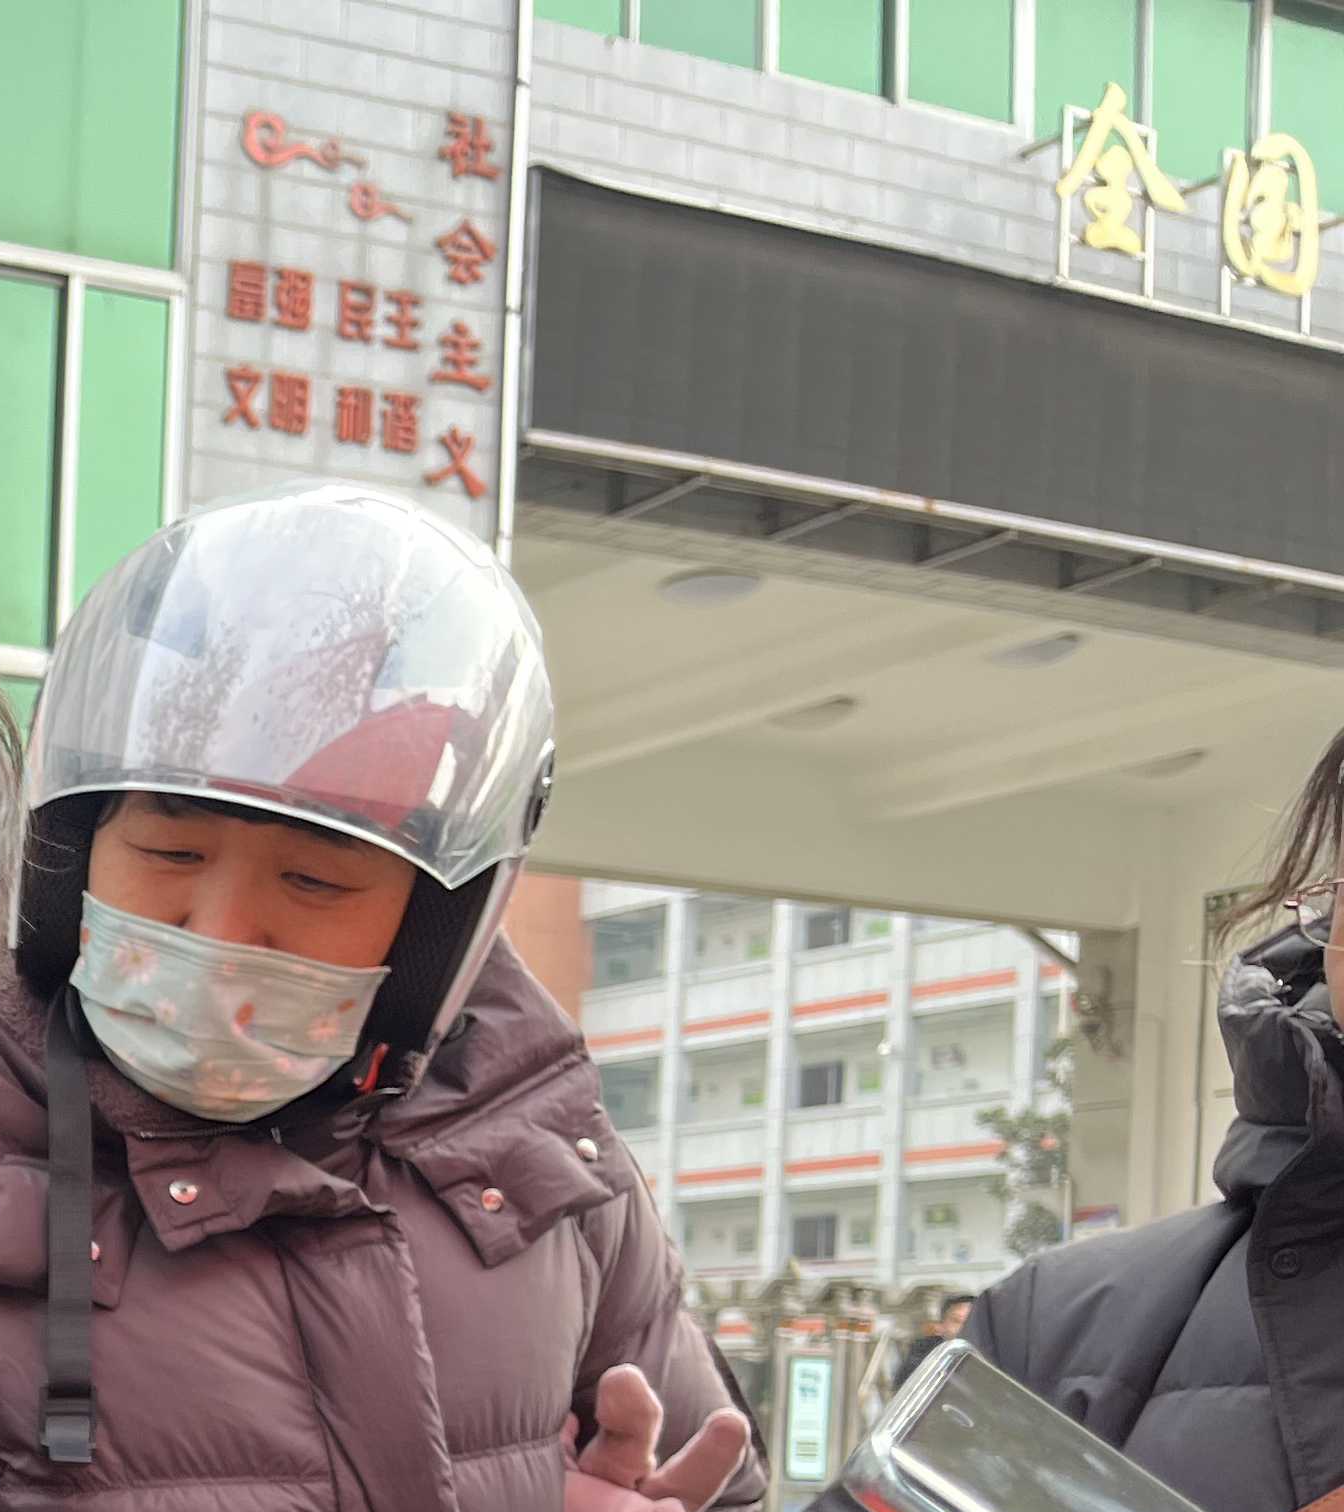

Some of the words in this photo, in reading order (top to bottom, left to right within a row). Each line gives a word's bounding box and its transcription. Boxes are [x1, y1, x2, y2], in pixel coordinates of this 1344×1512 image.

[228, 262, 315, 332] 富强
[424, 111, 502, 498] 社会主义
[222, 363, 311, 436] 文明
[336, 385, 423, 454] 和谐
